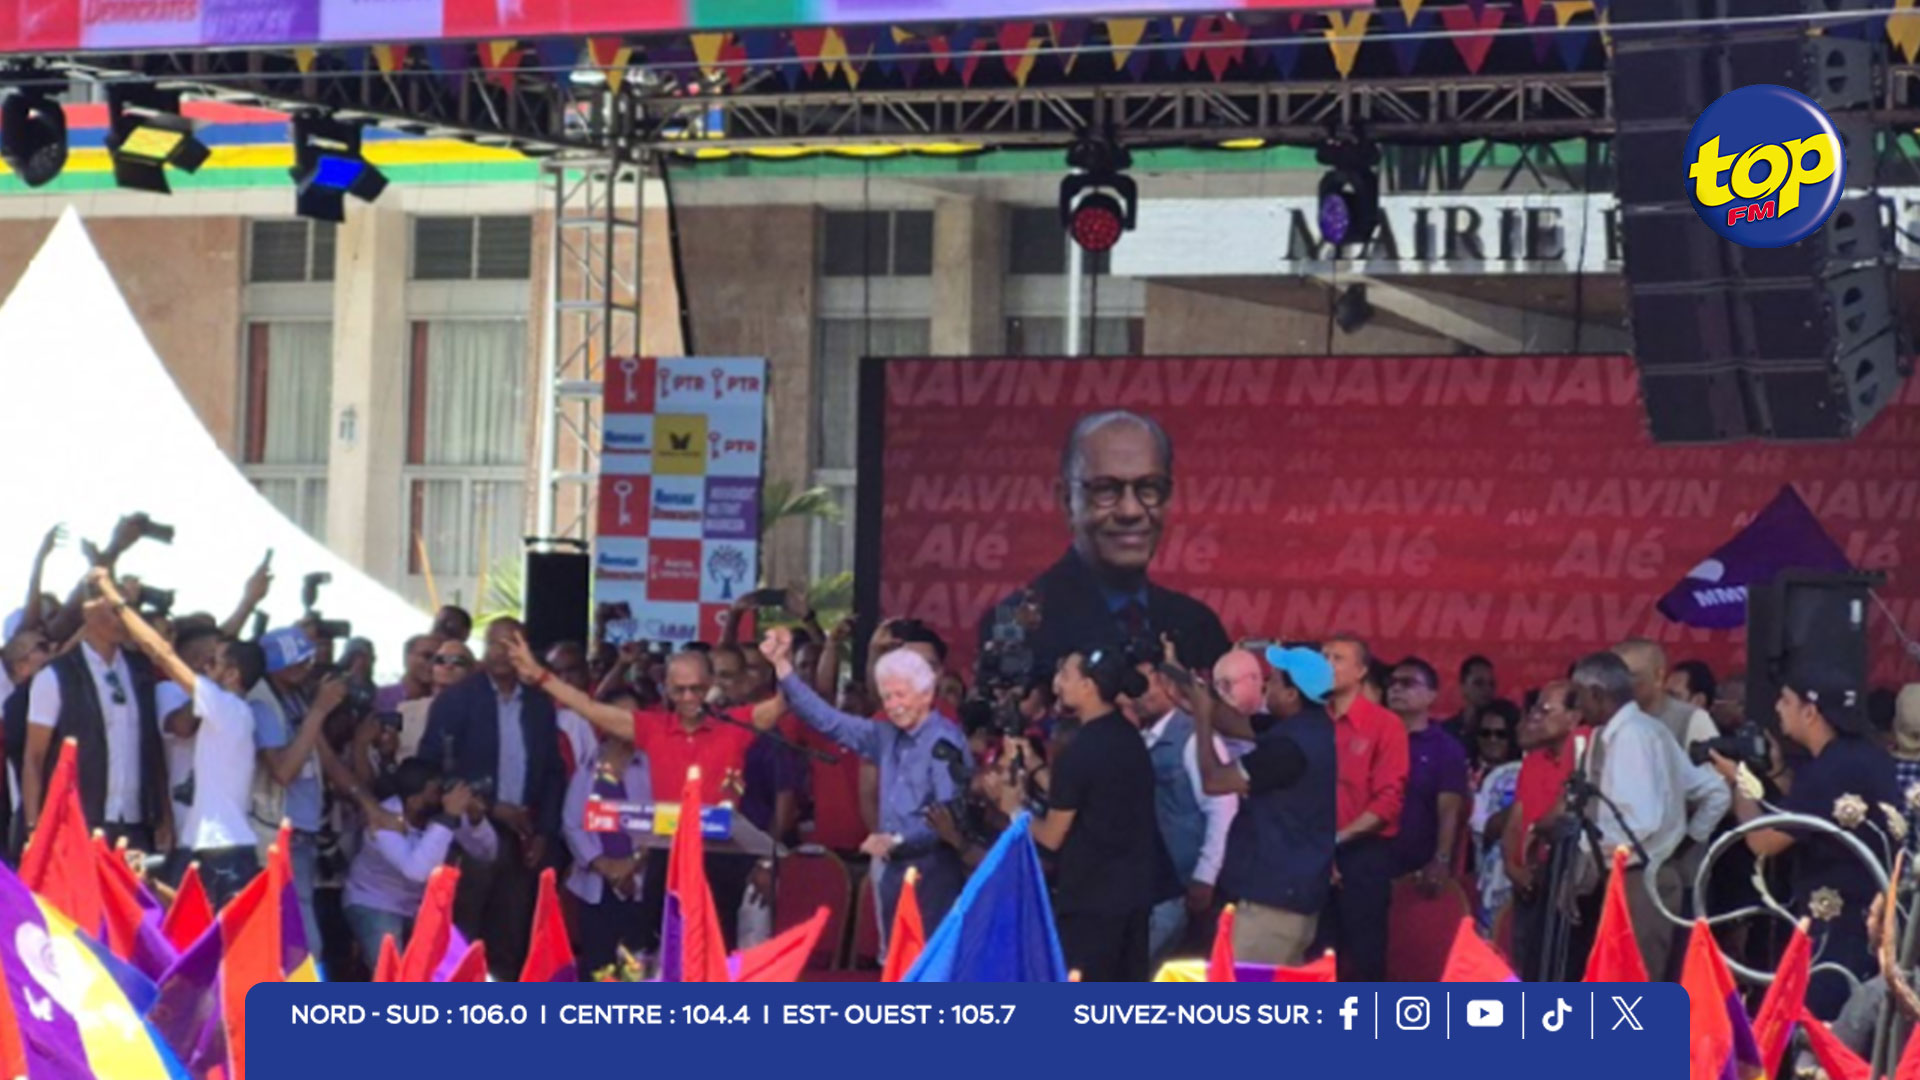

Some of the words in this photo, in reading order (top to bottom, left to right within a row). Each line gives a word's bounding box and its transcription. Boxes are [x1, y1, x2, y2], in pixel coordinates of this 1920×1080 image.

[1281, 207, 1562, 260] MAIRIE
[727, 376, 759, 392] PTR
[1072, 358, 1278, 406] NAVIN
[1285, 358, 1498, 406] NAVIN
[1506, 358, 1640, 406] NAV
[906, 475, 1057, 512] NAVIN
[1325, 477, 1495, 516] NAVIN
[1546, 478, 1722, 519] NAVIN
[912, 516, 1009, 571] Alé
[1148, 522, 1220, 574] lé
[1329, 524, 1438, 578] Alé
[1549, 527, 1666, 580] Alé
[1281, 588, 1493, 639] NAVIN
